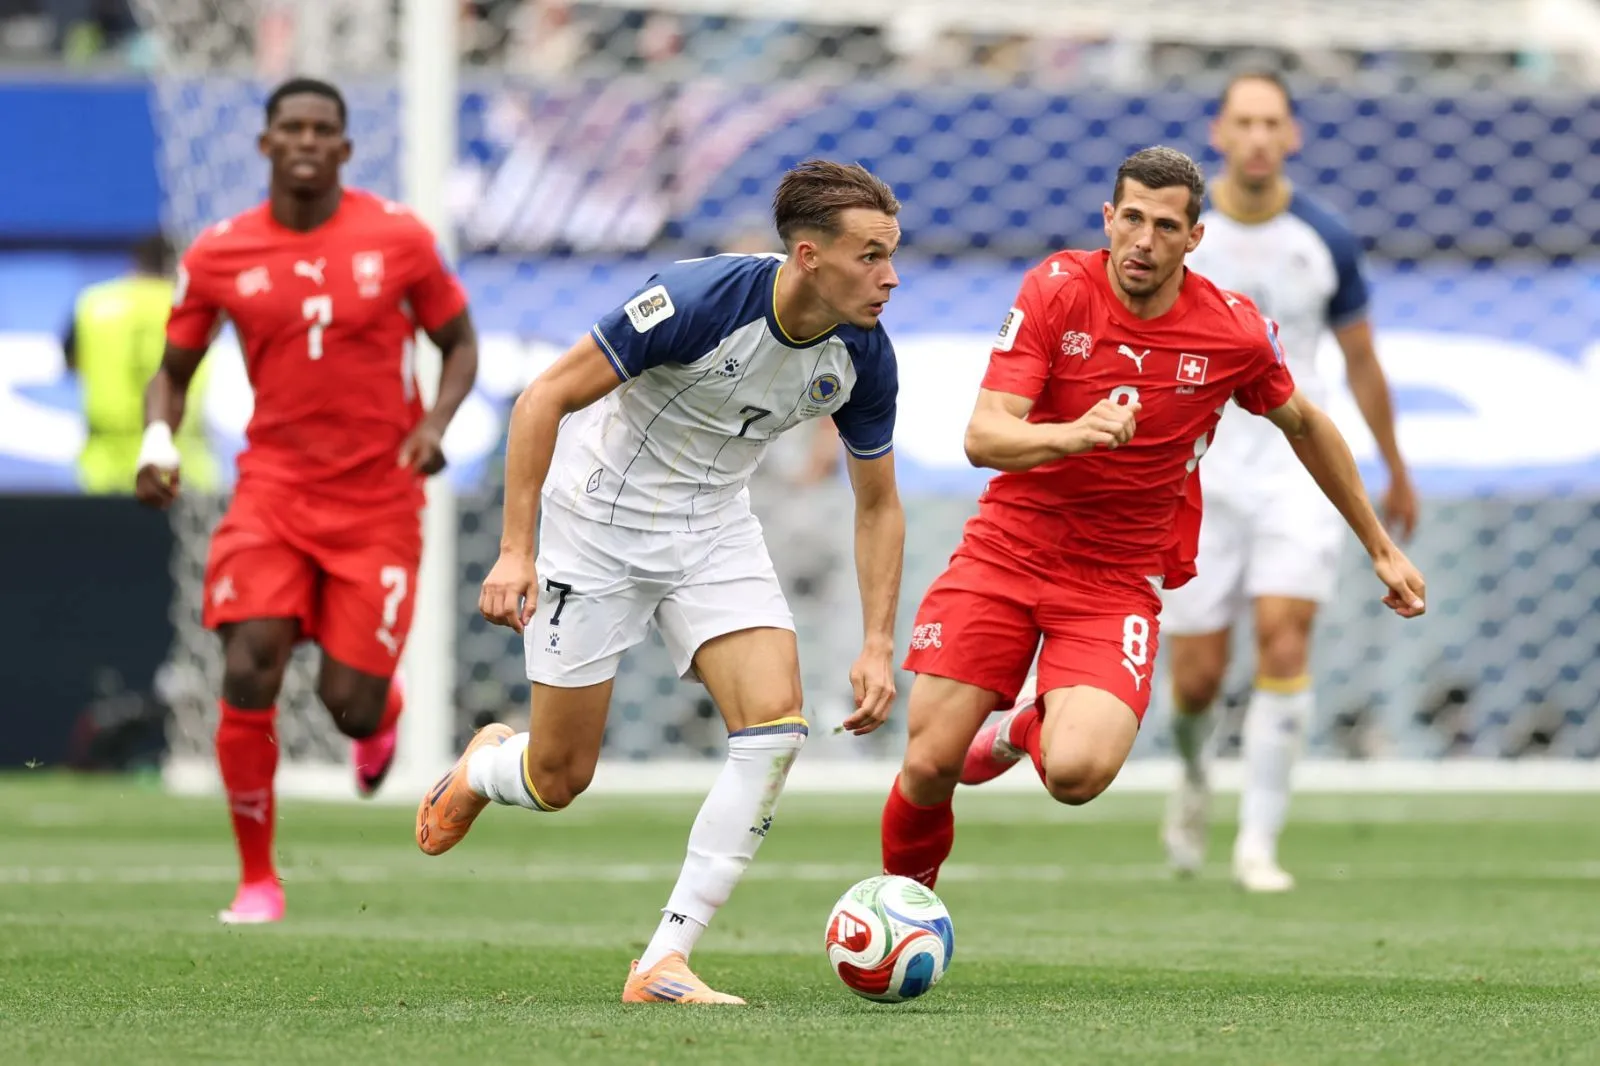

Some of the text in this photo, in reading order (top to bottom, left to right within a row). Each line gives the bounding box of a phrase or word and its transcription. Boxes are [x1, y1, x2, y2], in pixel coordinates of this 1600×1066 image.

[302, 294, 333, 361] 7
[714, 369, 738, 379] KELME
[739, 405, 773, 437] 7
[380, 565, 408, 628] 7
[545, 578, 572, 626] 7
[544, 647, 562, 656] KELME
[1123, 614, 1149, 666] 8
